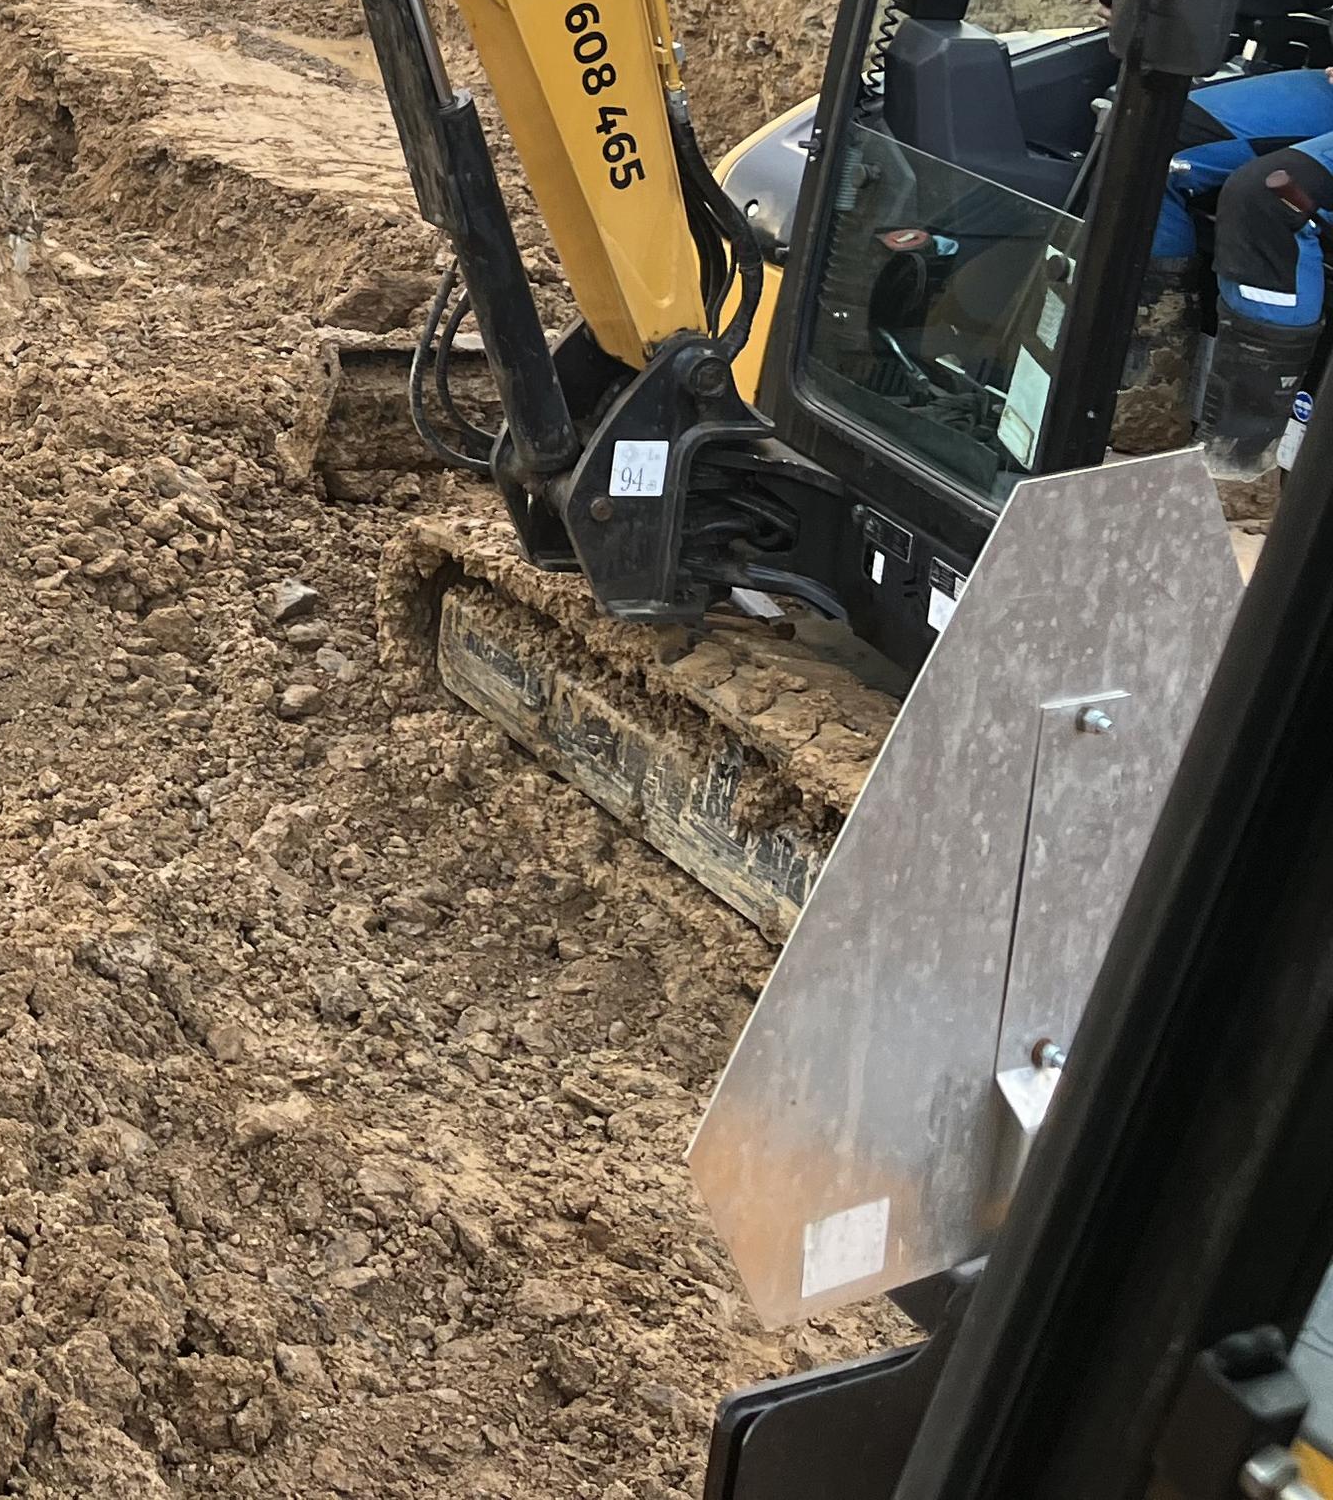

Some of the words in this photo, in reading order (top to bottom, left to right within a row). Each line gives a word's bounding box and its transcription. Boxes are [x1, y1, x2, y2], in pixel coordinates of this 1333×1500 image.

[564, 2, 618, 97] 608
[595, 106, 646, 190] 465
[620, 466, 645, 492] 94
